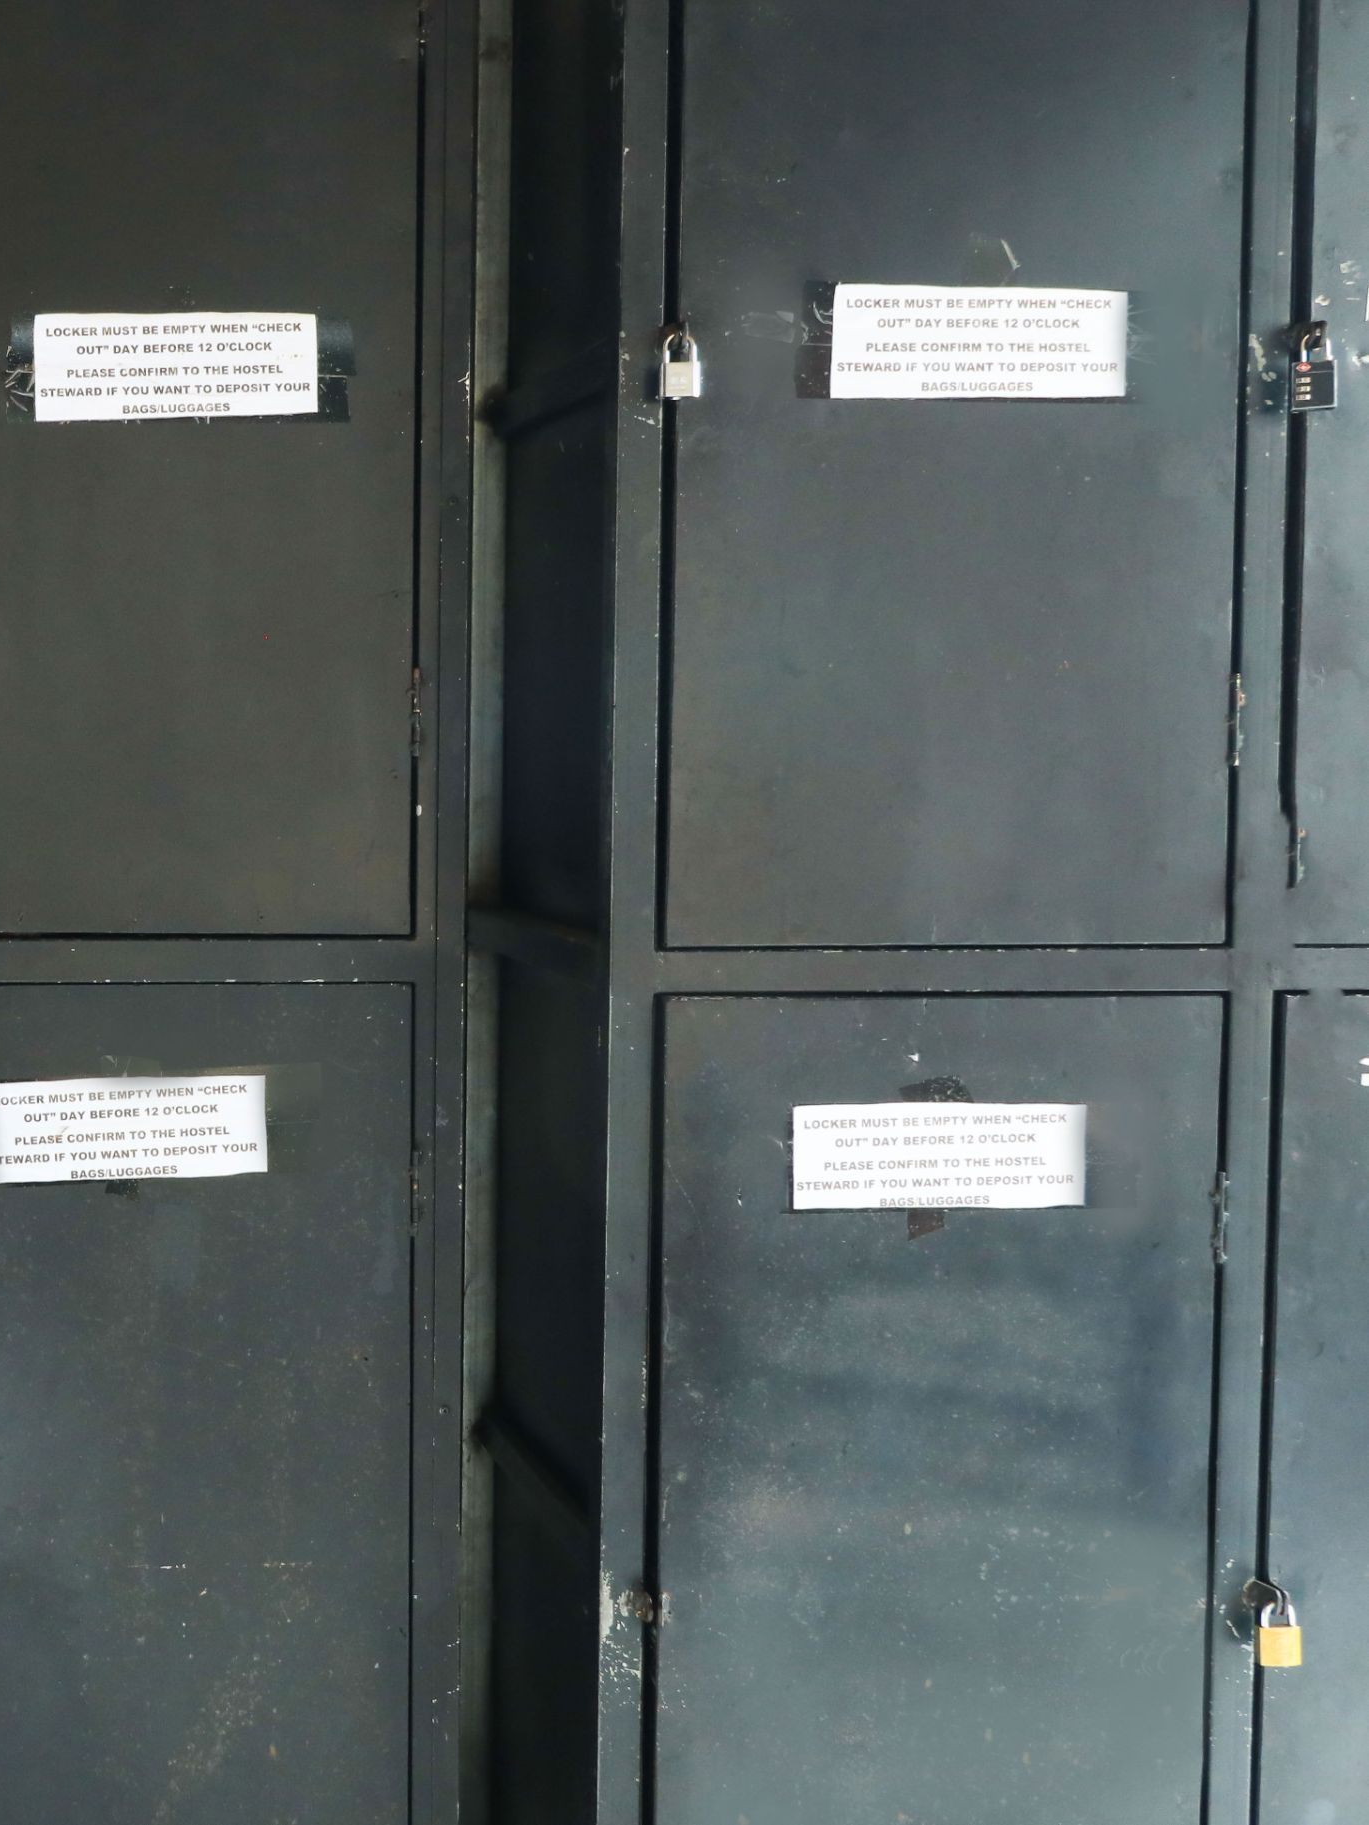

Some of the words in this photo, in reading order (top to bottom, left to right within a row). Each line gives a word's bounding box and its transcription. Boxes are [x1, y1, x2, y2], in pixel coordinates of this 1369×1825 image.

[846, 298, 900, 309] LOCKER
[903, 298, 942, 309] MUST
[946, 298, 963, 308] BE
[967, 298, 1013, 308] EMPTY
[1016, 299, 1057, 309] WHEN
[45, 327, 98, 337] LOCKER
[101, 326, 138, 336] MUST
[142, 325, 159, 335] BE
[162, 324, 206, 334] EMPTY
[209, 323, 248, 333] WHEN
[914, 318, 942, 328] DAY
[946, 318, 999, 328] BEFORE
[1004, 318, 1019, 328] 12
[112, 344, 139, 354] DAY
[142, 343, 194, 354] BEFORE
[198, 342, 213, 352] 12
[66, 368, 116, 378] PLEASE
[119, 367, 178, 377] CONFIRM
[181, 366, 200, 376] TO
[202, 365, 229, 375] THE
[232, 364, 283, 375] HOSTEL
[39, 387, 102, 397] STEWARD
[106, 386, 118, 396] IF
[121, 386, 149, 395] YOU
[152, 385, 191, 395] WANT
[194, 384, 212, 394] TO
[215, 383, 271, 393] DEPOSIT
[274, 382, 311, 392] YOUR
[121, 402, 231, 414] BAGS/LUGGAGES
[47, 1092, 84, 1103] MUST
[88, 1091, 105, 1101] BE
[108, 1088, 152, 1100] EMPTY
[155, 1086, 194, 1098] WHEN
[59, 1111, 85, 1121] DAY
[89, 1108, 140, 1119] BEFORE
[144, 1107, 159, 1116] 12
[803, 1118, 857, 1130] LOCKER
[860, 1117, 899, 1128] MUST
[902, 1117, 919, 1127] BE
[923, 1116, 968, 1126] EMPTY
[971, 1114, 1012, 1125] WHEN
[14, 1134, 63, 1146] PLEASE
[66, 1131, 125, 1143] CONFIRM
[128, 1130, 147, 1140] TO
[149, 1128, 176, 1139] THE
[179, 1126, 230, 1137] HOSTEL
[871, 1136, 899, 1147] DAY
[902, 1135, 955, 1146] BEFORE
[959, 1134, 974, 1144] 12
